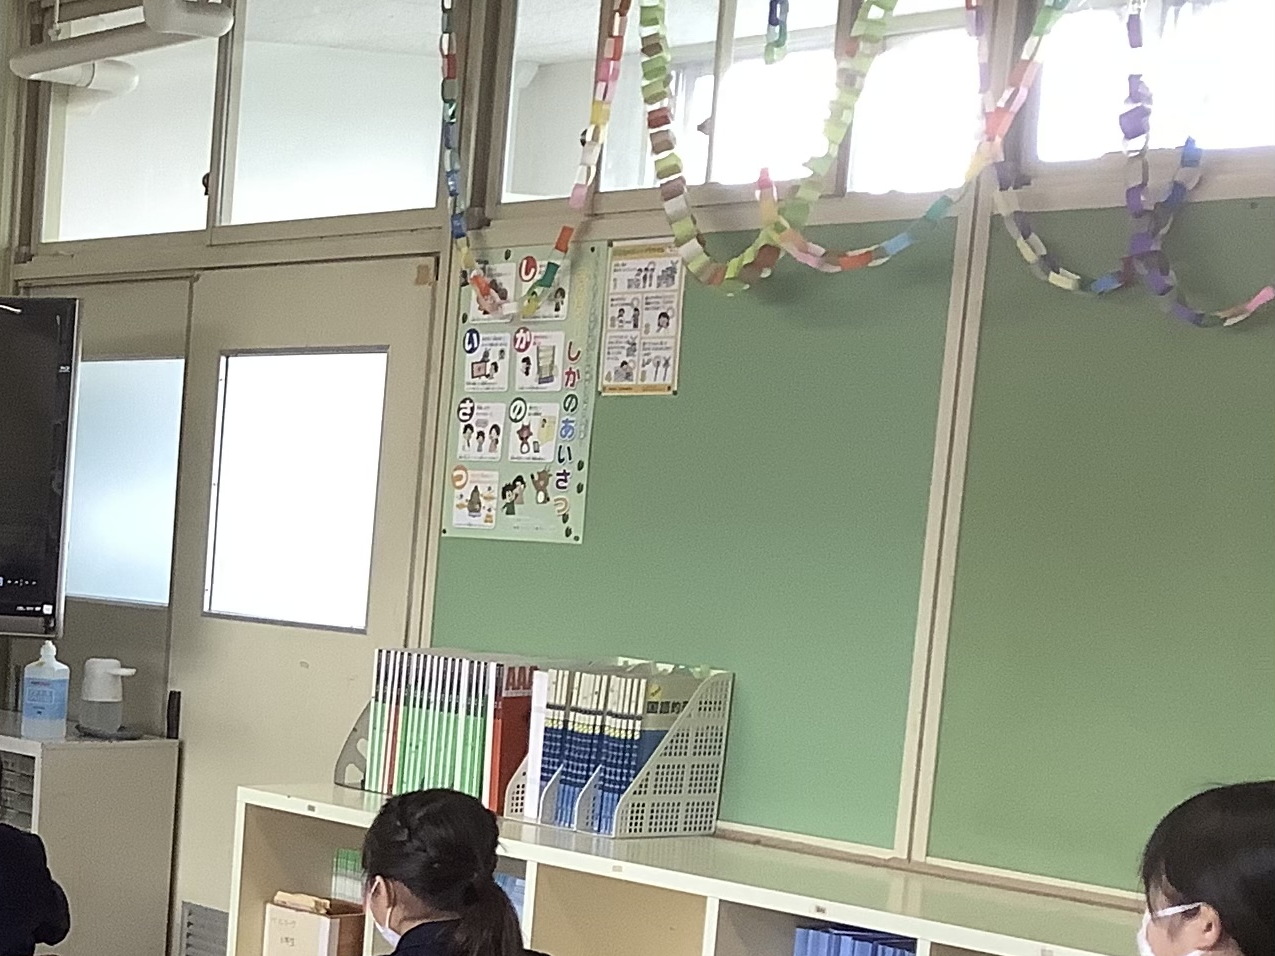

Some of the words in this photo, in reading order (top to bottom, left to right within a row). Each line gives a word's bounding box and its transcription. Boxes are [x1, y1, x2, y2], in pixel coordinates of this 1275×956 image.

[523, 258, 537, 279] し
[464, 331, 480, 352] い
[514, 328, 532, 351] か
[459, 399, 475, 421] さ
[510, 399, 526, 422] の
[552, 341, 581, 515] しかのあいさつ
